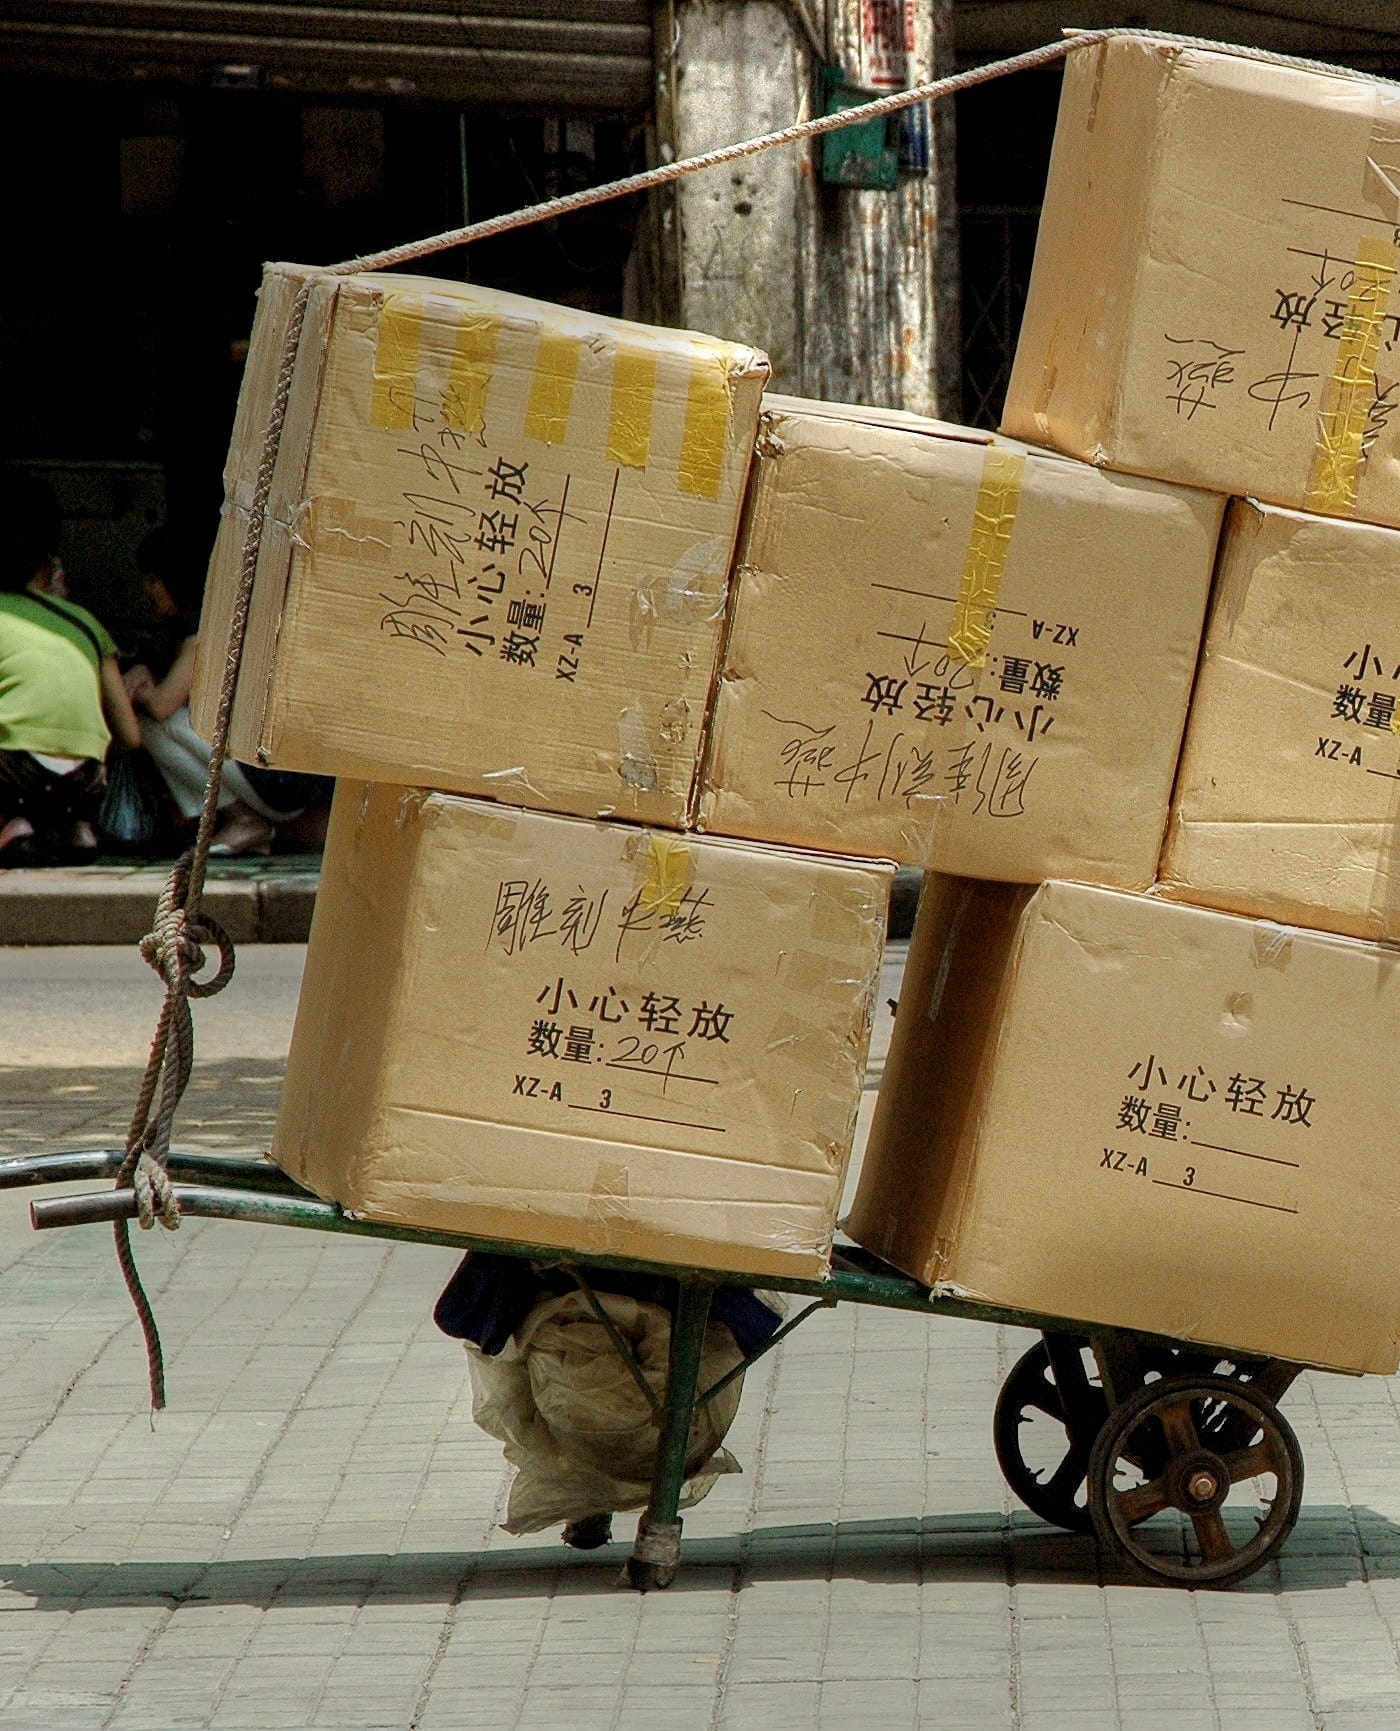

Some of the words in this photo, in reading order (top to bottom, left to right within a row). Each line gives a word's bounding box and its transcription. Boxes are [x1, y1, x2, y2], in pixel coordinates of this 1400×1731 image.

[457, 457, 529, 655] 小心轻放
[555, 633, 584, 682] XZ-A
[573, 583, 593, 597] 3
[1032, 619, 1080, 647] XZ-A
[860, 671, 1056, 741] 小心轻放
[1314, 737, 1362, 767] XZ-A
[536, 977, 735, 1043] 小心轻放
[512, 1074, 562, 1102] XZ-A
[600, 1089, 612, 1109] 3
[1115, 1095, 1192, 1142] 数量:
[1127, 1054, 1316, 1128] 小心轻放
[1100, 1149, 1148, 1177] XZ-A
[1183, 1167, 1196, 1186] 3
